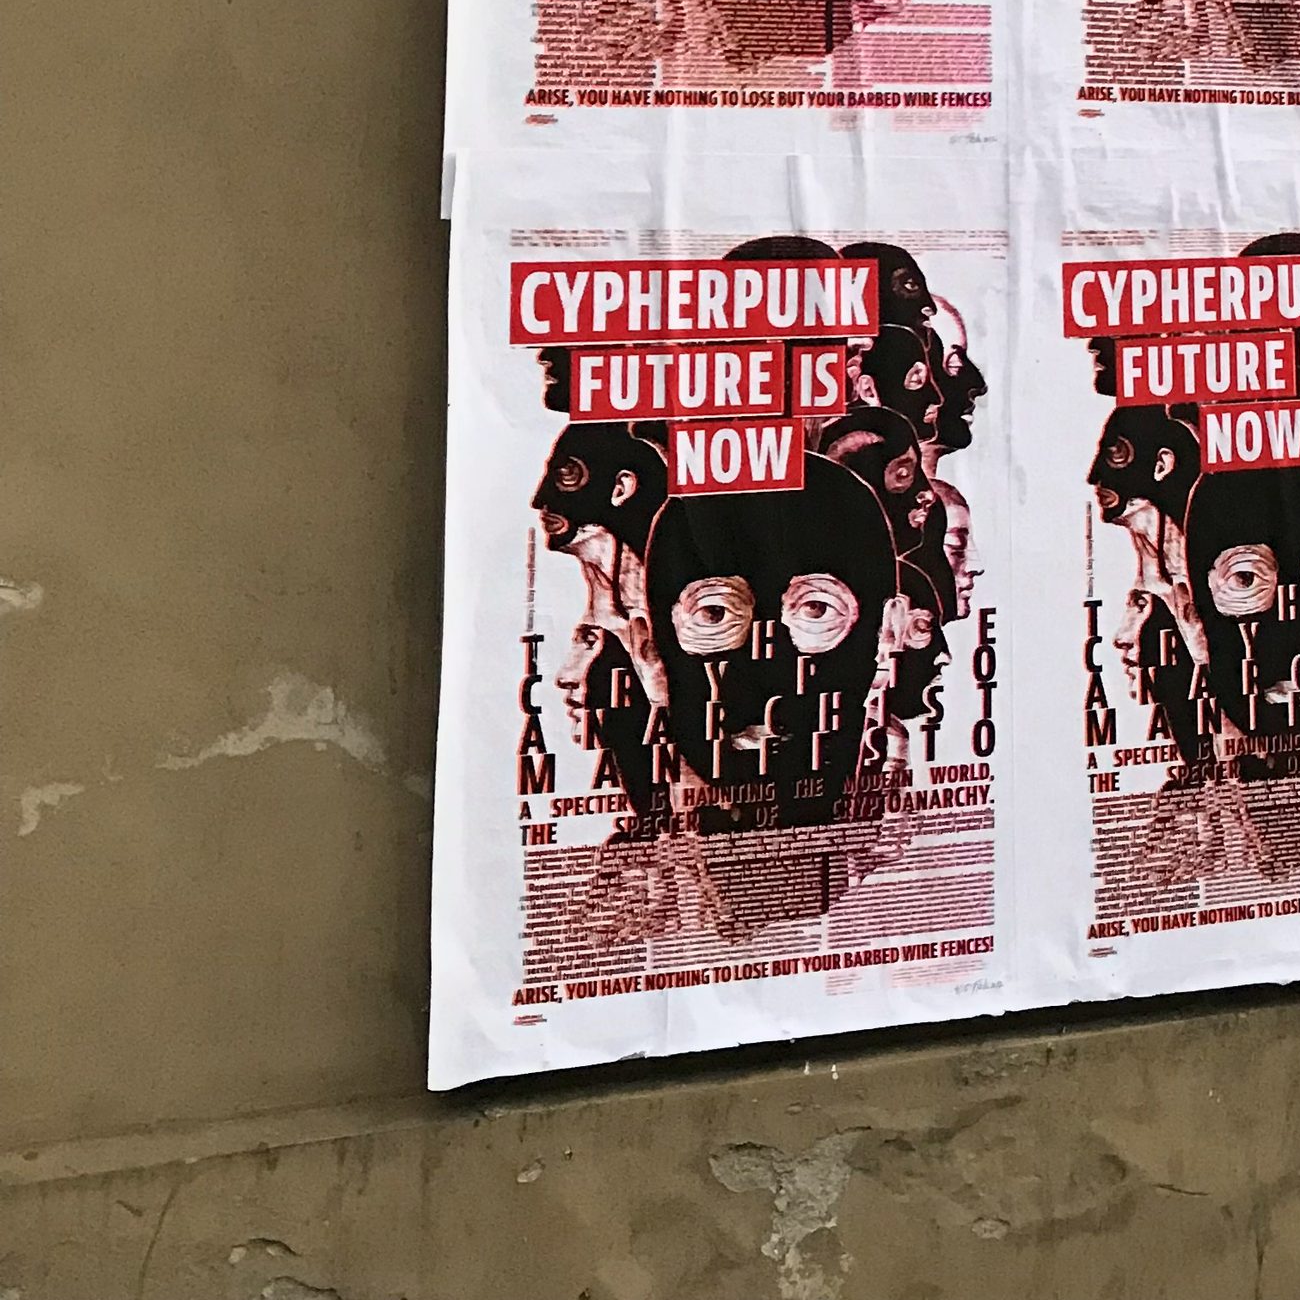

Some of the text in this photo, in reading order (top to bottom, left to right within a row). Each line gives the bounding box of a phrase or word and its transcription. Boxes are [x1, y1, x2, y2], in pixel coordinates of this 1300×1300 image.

[525, 89, 991, 106] ARISE, YOU HAVE NOTHING TO LOSE BUT YOUR BARBED WIRE FENCES!
[1077, 86, 1116, 102] ARISE,
[1119, 87, 1145, 103] YOU
[1147, 88, 1181, 103] HAVE
[1183, 89, 1237, 104] NOTHING
[1239, 90, 1255, 104] TO
[1257, 90, 1285, 105] LOSE
[520, 268, 869, 334] CYPHERPUNK
[580, 351, 837, 411] FUTURE IS
[1122, 340, 1286, 396] FUTURE
[677, 426, 792, 485] NOW
[1086, 752, 1098, 769] A
[1112, 744, 1180, 767] SPECTER
[1087, 772, 1120, 793] THE
[1166, 759, 1240, 786] SPECTER
[518, 801, 532, 820] A
[550, 793, 629, 818] SPECTER
[682, 782, 775, 808] HAUNTING
[794, 778, 823, 799] THE
[842, 769, 912, 794] MODERN
[518, 784, 994, 846] THE SPECTER OF CRYPTOANARCHY.
[1087, 920, 1129, 941] ARISE,
[1131, 916, 1159, 935] YOU
[1161, 911, 1197, 932] HAVE
[1198, 903, 1254, 927] NOTHING
[1257, 901, 1273, 919] TO
[513, 984, 562, 1008] ARISE,
[565, 980, 598, 1002] YOU
[600, 975, 642, 997] HAVE
[644, 967, 710, 992] NOTHING
[713, 965, 732, 984] TO
[734, 961, 769, 982] LOSE
[772, 957, 800, 977] BUT
[802, 953, 840, 973] YOUR
[843, 946, 899, 969] BARBED
[901, 942, 937, 962] WIRE
[940, 935, 994, 957] FENCES!
